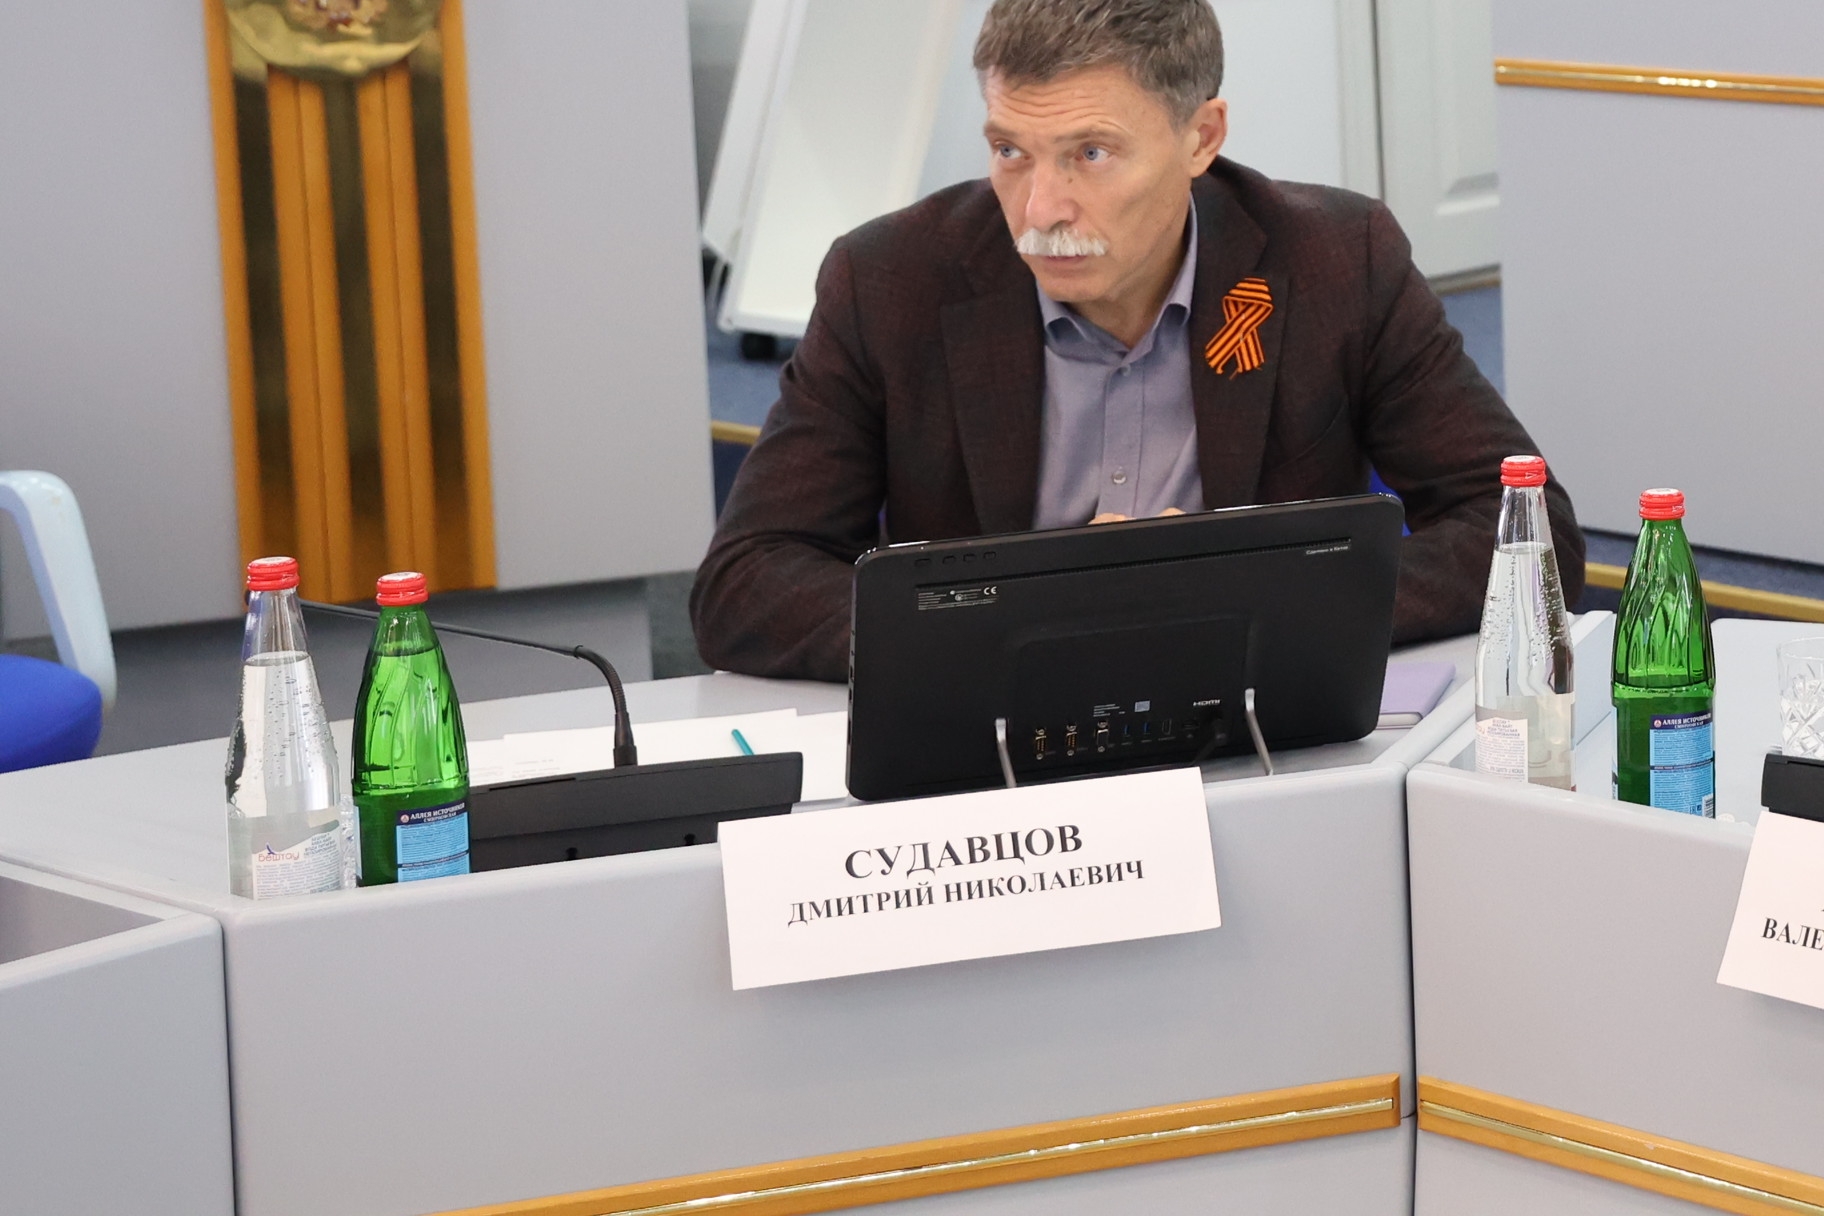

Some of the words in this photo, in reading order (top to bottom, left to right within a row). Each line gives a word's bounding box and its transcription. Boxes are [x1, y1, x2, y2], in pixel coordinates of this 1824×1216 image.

[844, 824, 1084, 880] СУДАВЦОВ
[787, 883, 935, 927] ДМИТРИЙ
[945, 860, 1145, 903] НИКОЛАЕВИЧ
